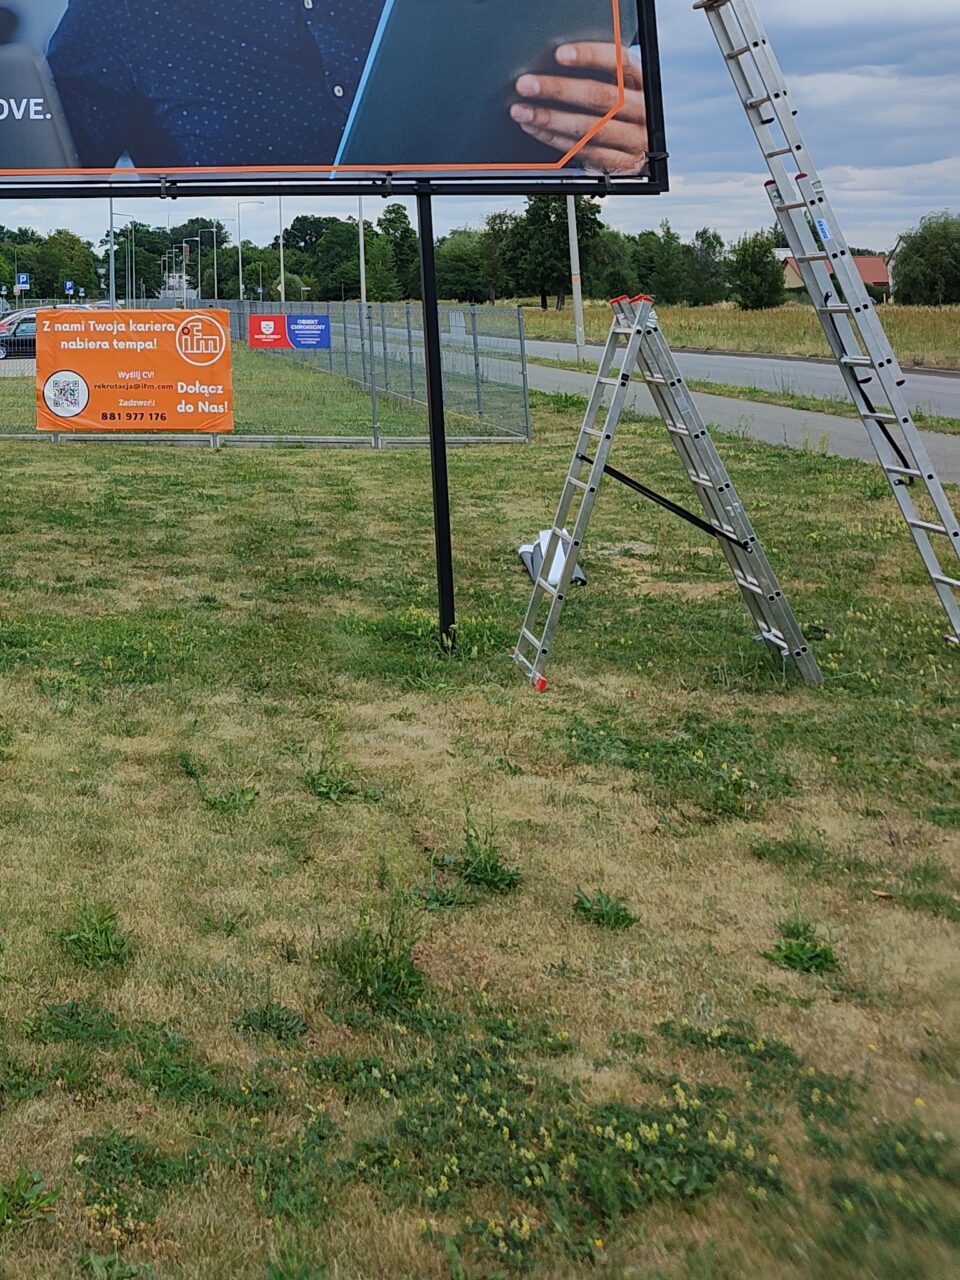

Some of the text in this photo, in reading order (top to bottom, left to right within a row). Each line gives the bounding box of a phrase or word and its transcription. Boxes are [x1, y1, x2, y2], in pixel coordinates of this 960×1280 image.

[43, 320, 175, 335] Z nami Twoja kariera
[60, 337, 158, 353] nabiera tempa!
[182, 322, 220, 354] ifm
[117, 371, 155, 380] Wyślij CV!
[93, 383, 174, 391] rekrutacja@ifm.com
[176, 380, 224, 397] Dołącz
[176, 400, 229, 413] do Nas!
[101, 412, 167, 421] 881 977 176
